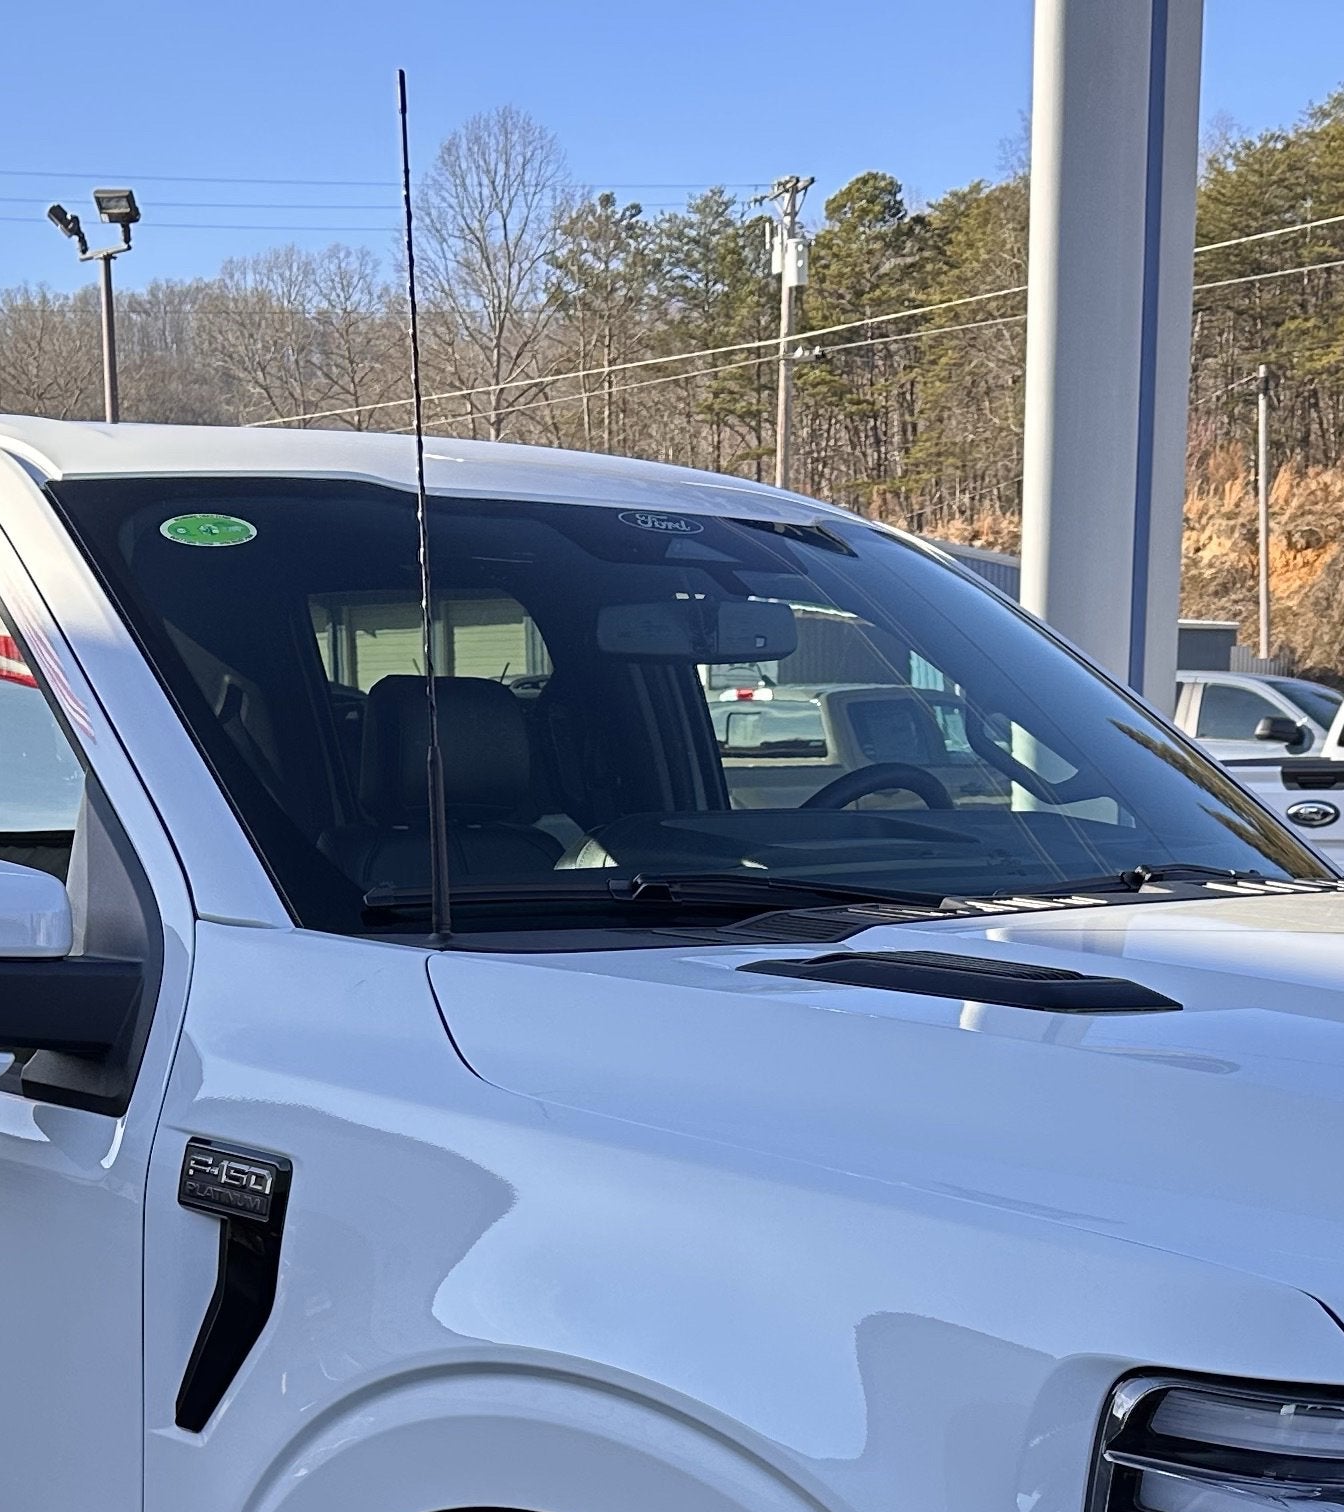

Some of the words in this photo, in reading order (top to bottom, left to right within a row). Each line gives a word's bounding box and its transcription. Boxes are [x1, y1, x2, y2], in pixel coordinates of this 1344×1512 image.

[633, 513, 692, 532] Ford
[188, 1154, 273, 1195] F-150
[185, 1180, 262, 1211] PLATINUM
